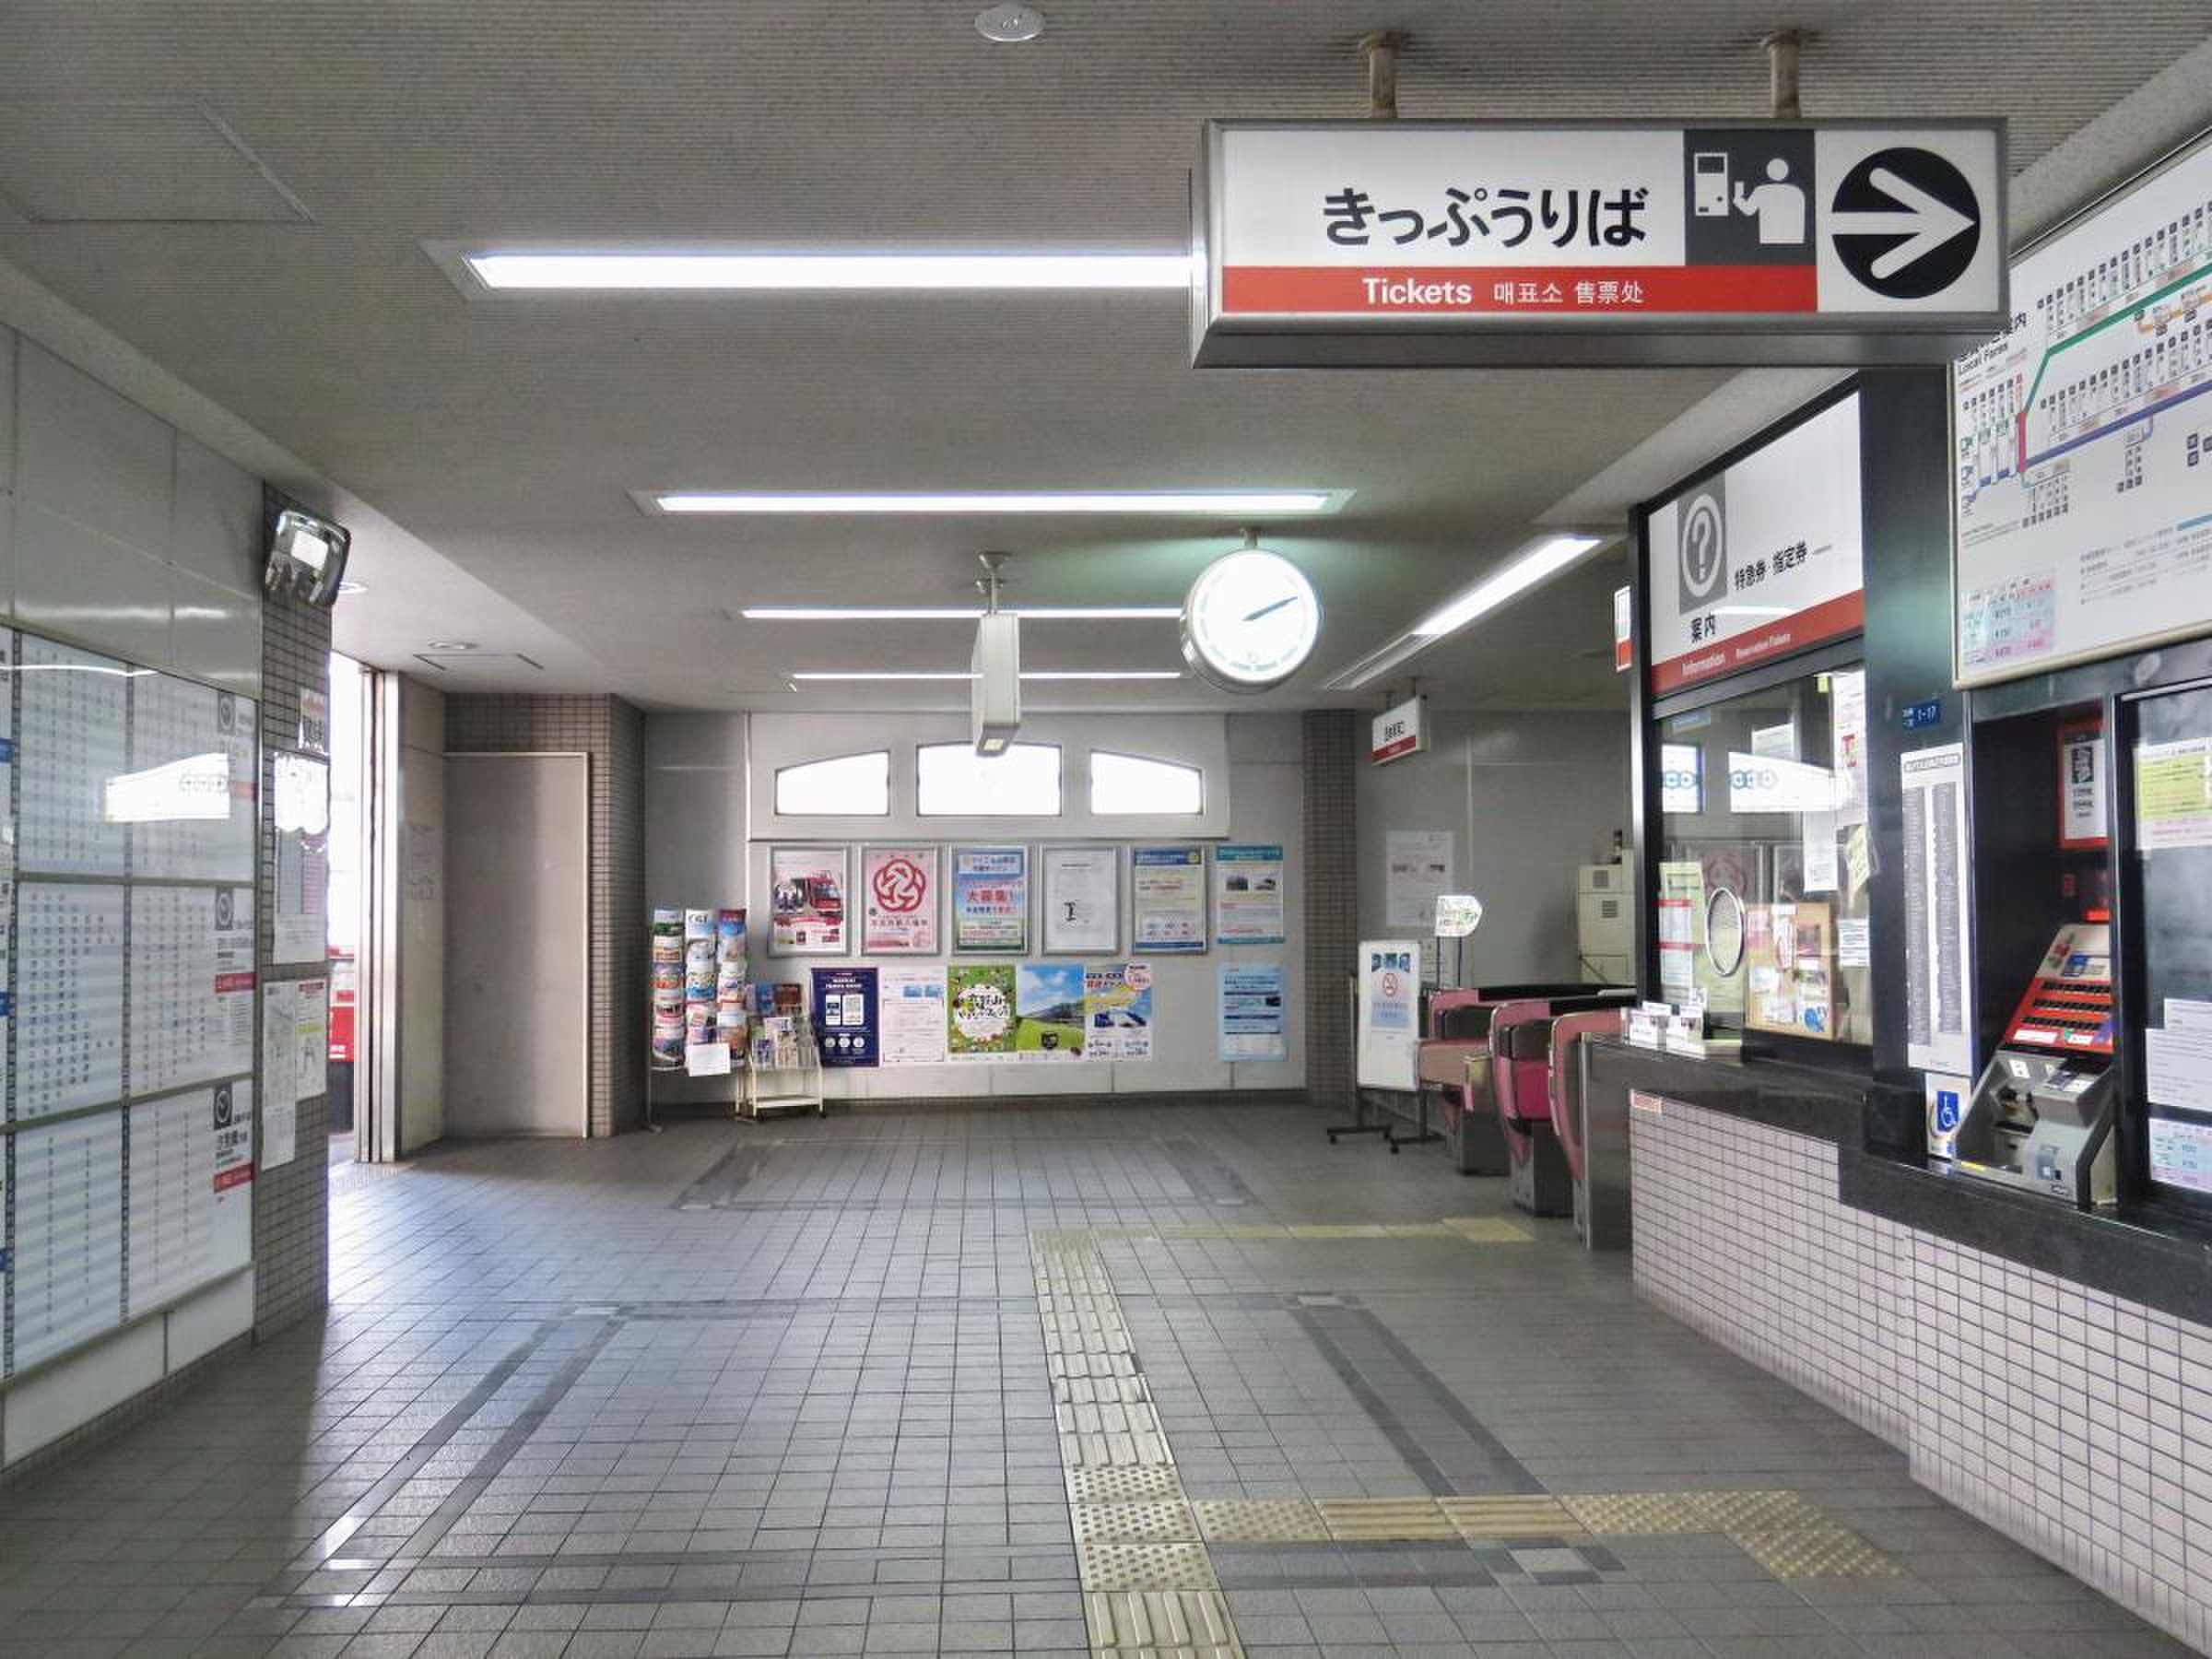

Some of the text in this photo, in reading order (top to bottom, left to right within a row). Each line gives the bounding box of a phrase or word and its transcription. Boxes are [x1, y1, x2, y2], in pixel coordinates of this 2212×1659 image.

[1324, 187, 1650, 248] きっぷうりば
[1362, 277, 1472, 304] Tickets
[1493, 280, 1563, 304] 매표소
[1574, 280, 1643, 304] 售票处
[1691, 614, 1715, 644] 案内
